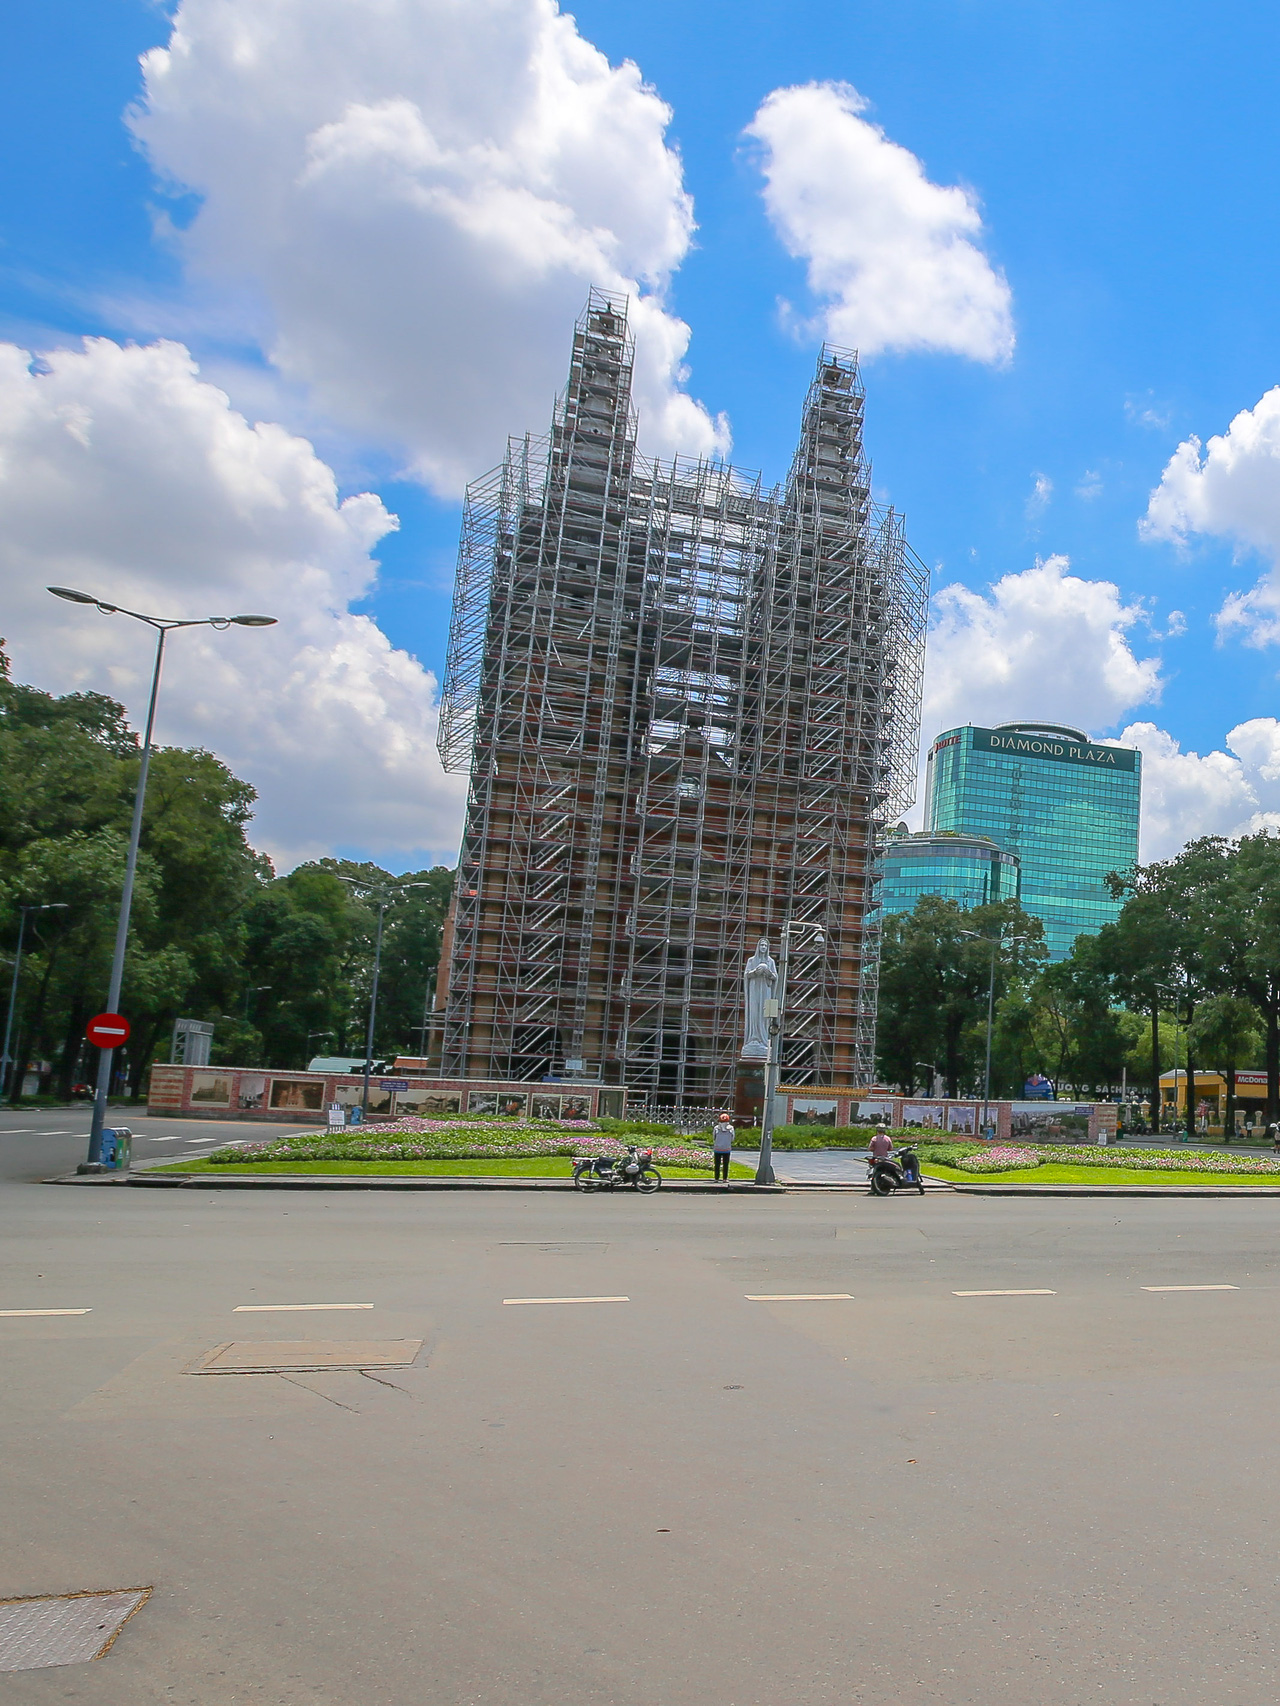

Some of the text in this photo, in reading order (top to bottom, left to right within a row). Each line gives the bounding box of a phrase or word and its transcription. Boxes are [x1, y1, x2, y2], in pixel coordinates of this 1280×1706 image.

[990, 735, 1116, 764] DIAMOND PLAZA
[1237, 1075, 1268, 1084] McDona
